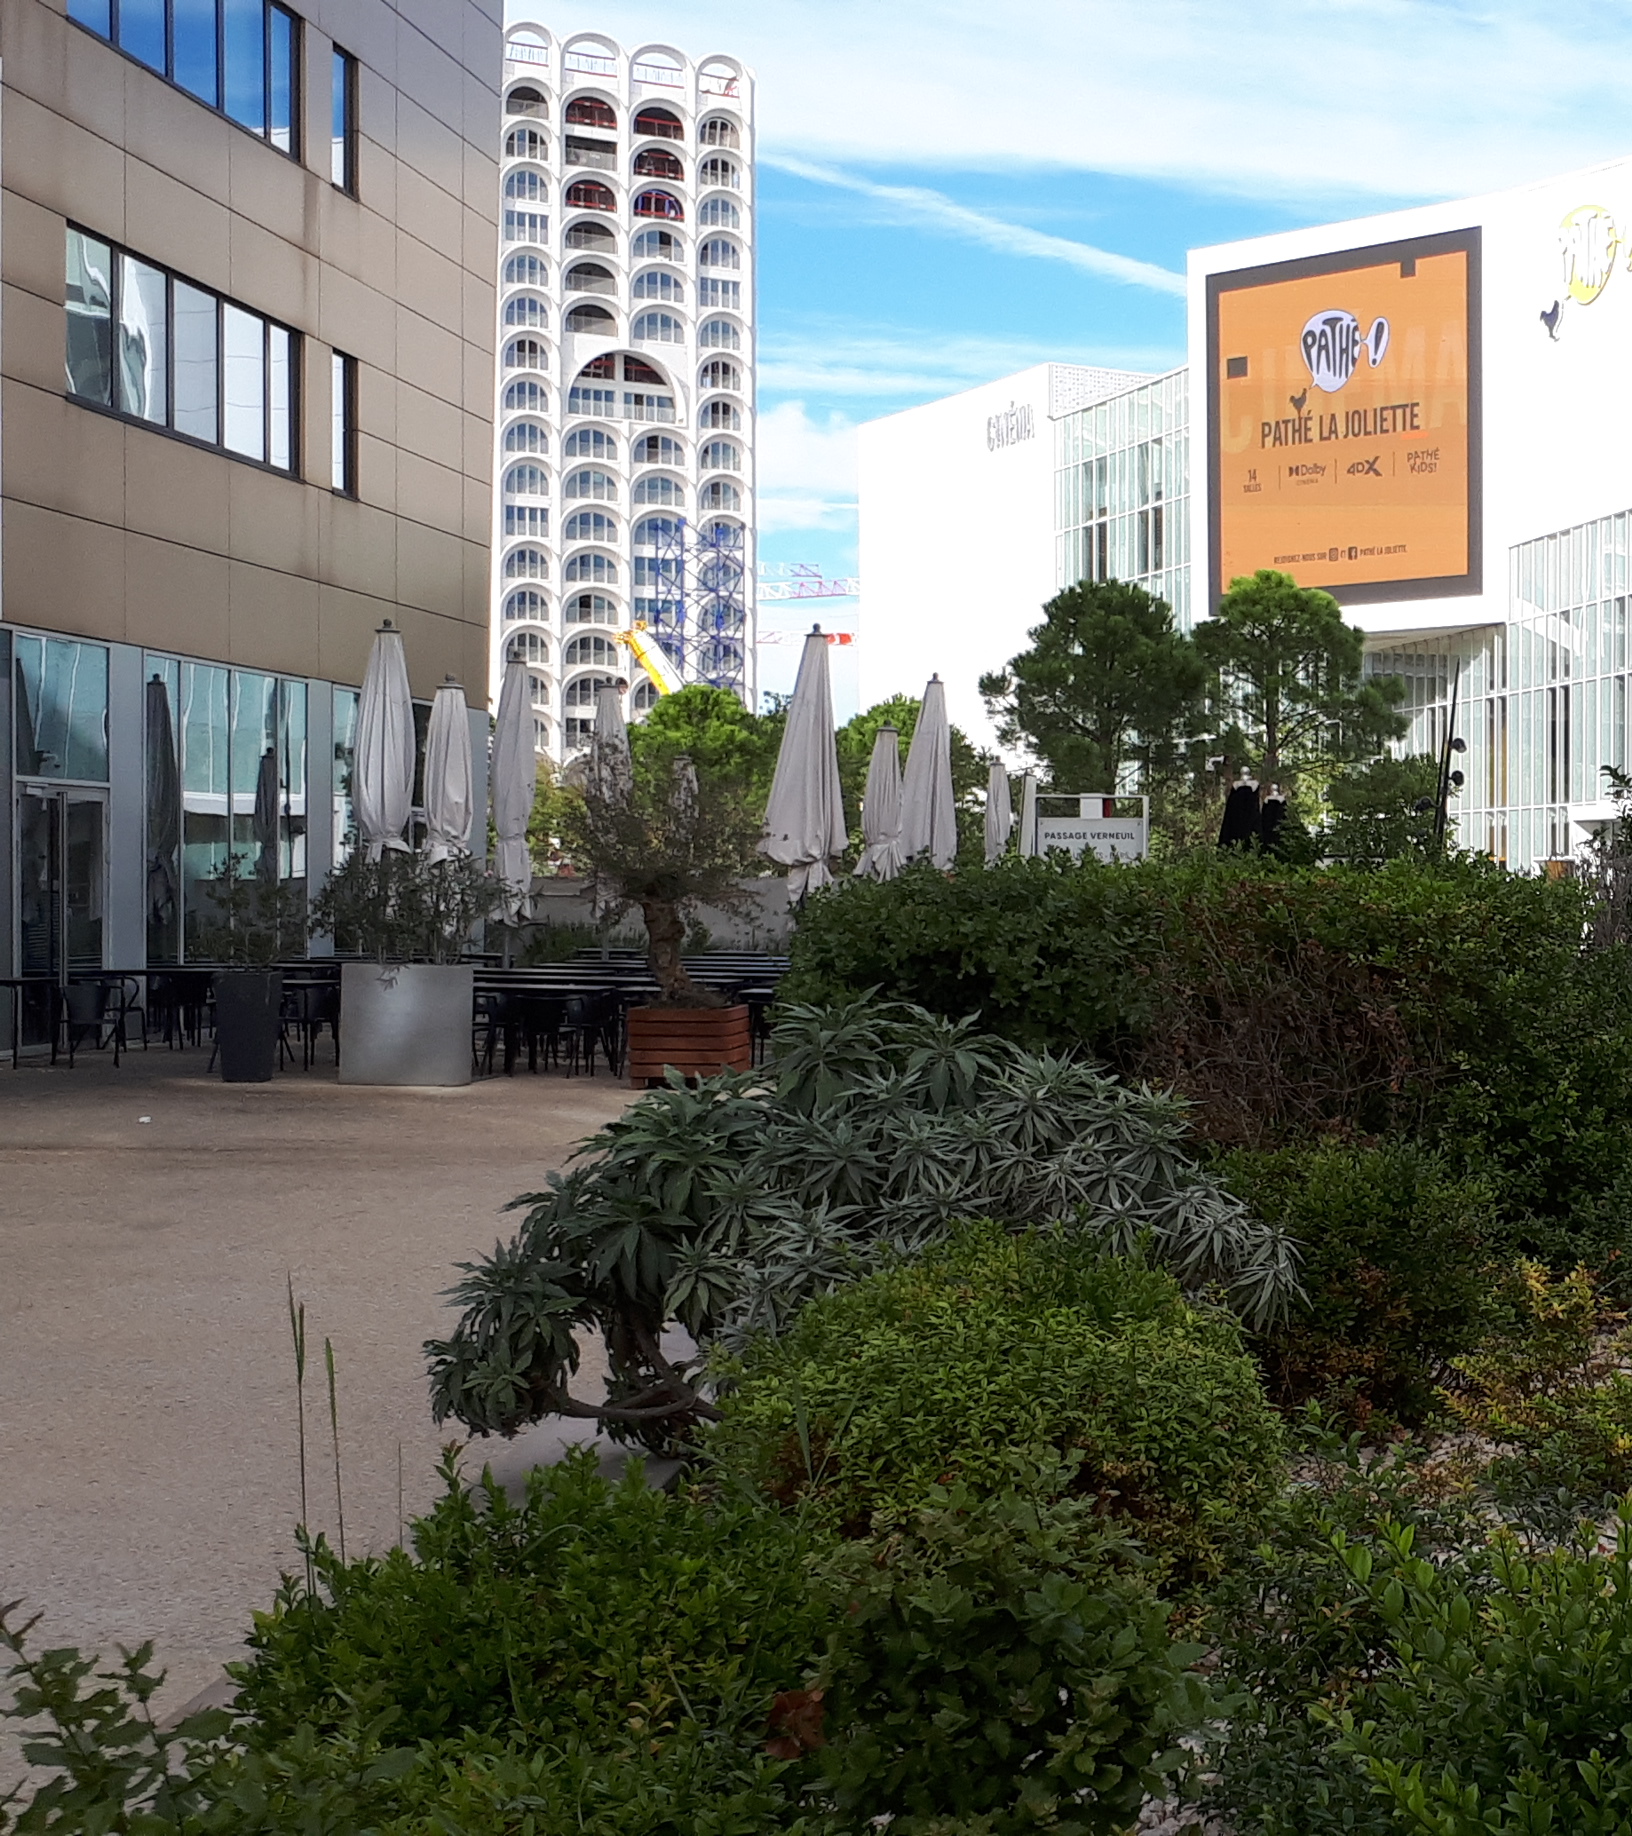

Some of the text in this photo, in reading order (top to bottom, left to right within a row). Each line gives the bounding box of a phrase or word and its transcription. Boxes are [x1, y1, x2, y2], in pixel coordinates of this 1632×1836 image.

[1261, 402, 1420, 449] PATHÉ LA JOLIETTE
[1407, 447, 1440, 462] PATHÉ
[1301, 463, 1326, 476] Dolby
[1347, 456, 1382, 477] 4DX
[1248, 469, 1257, 483] 14
[1045, 832, 1135, 840] PASSAGE VERNEUIL
